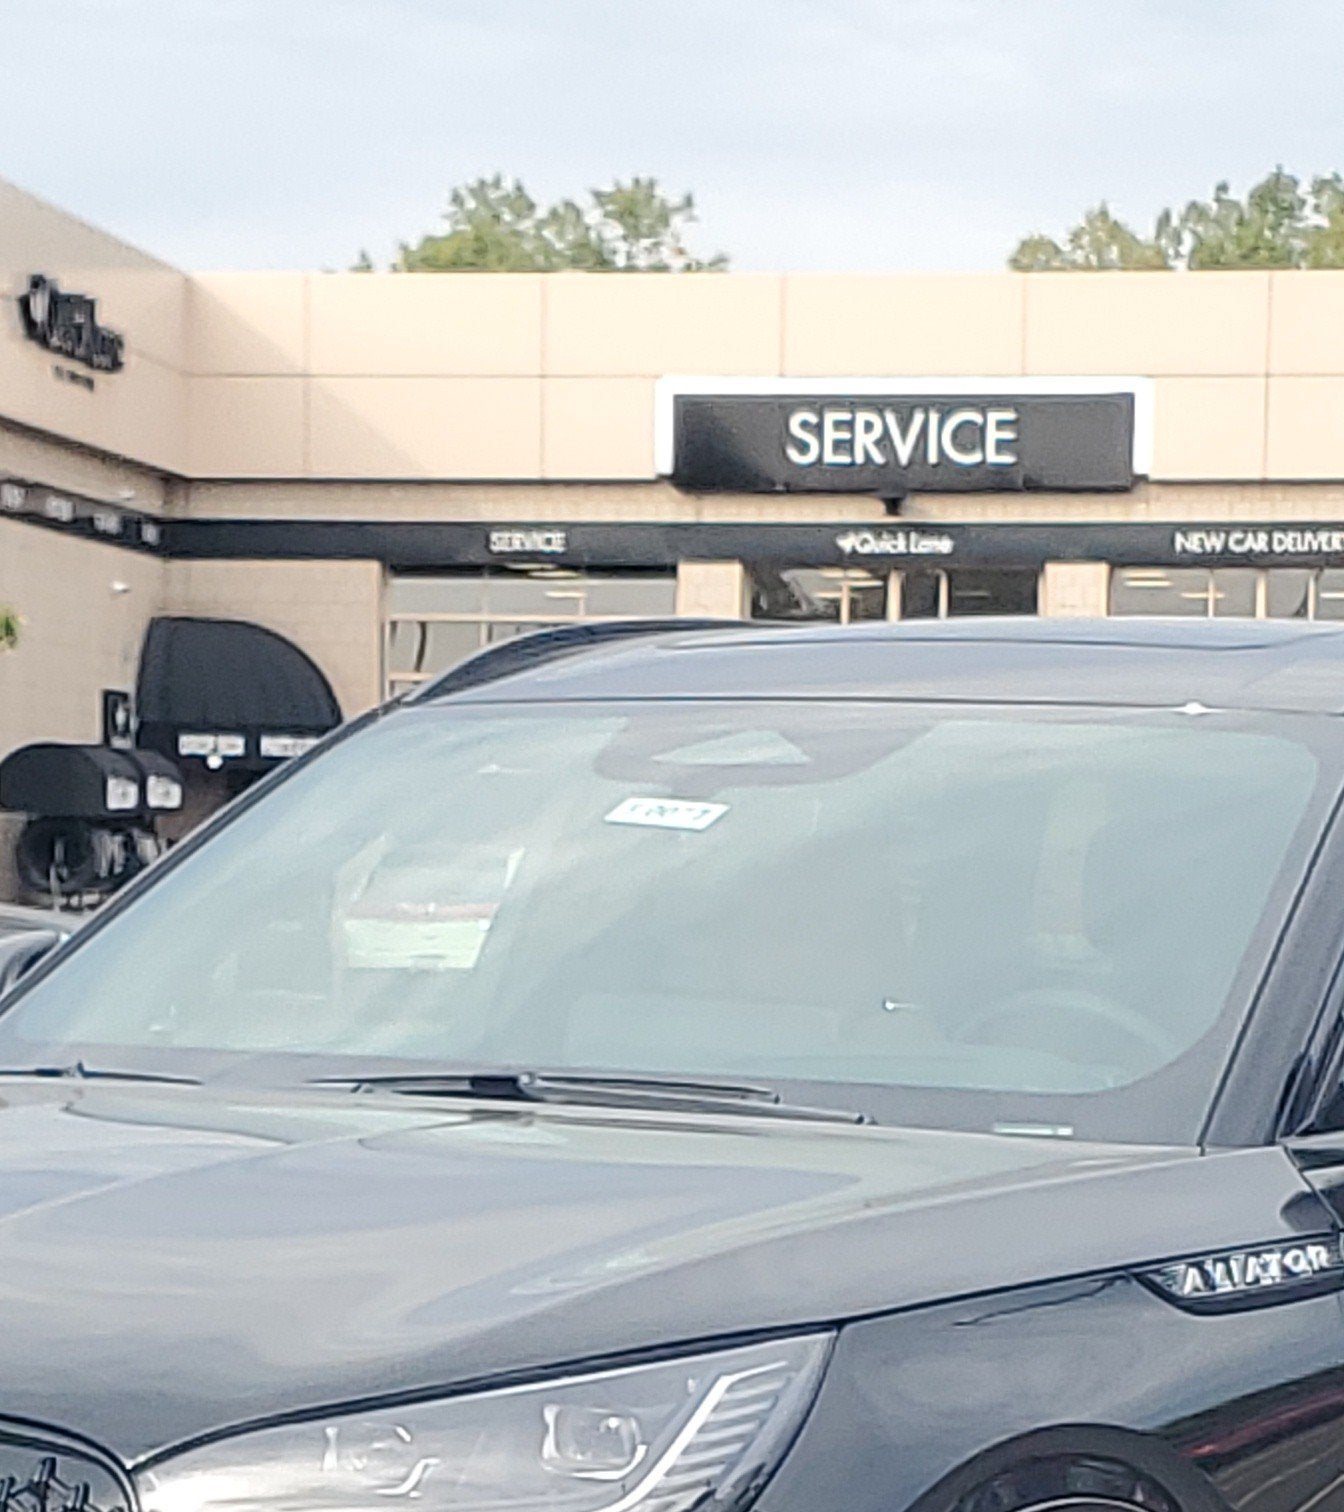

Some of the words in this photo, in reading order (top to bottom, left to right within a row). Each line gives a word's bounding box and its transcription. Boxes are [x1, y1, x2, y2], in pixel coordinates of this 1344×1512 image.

[785, 407, 1019, 465] SERVICE
[489, 530, 566, 553] SERVICE
[1174, 530, 1225, 554] NEW
[1227, 530, 1269, 554] CAR
